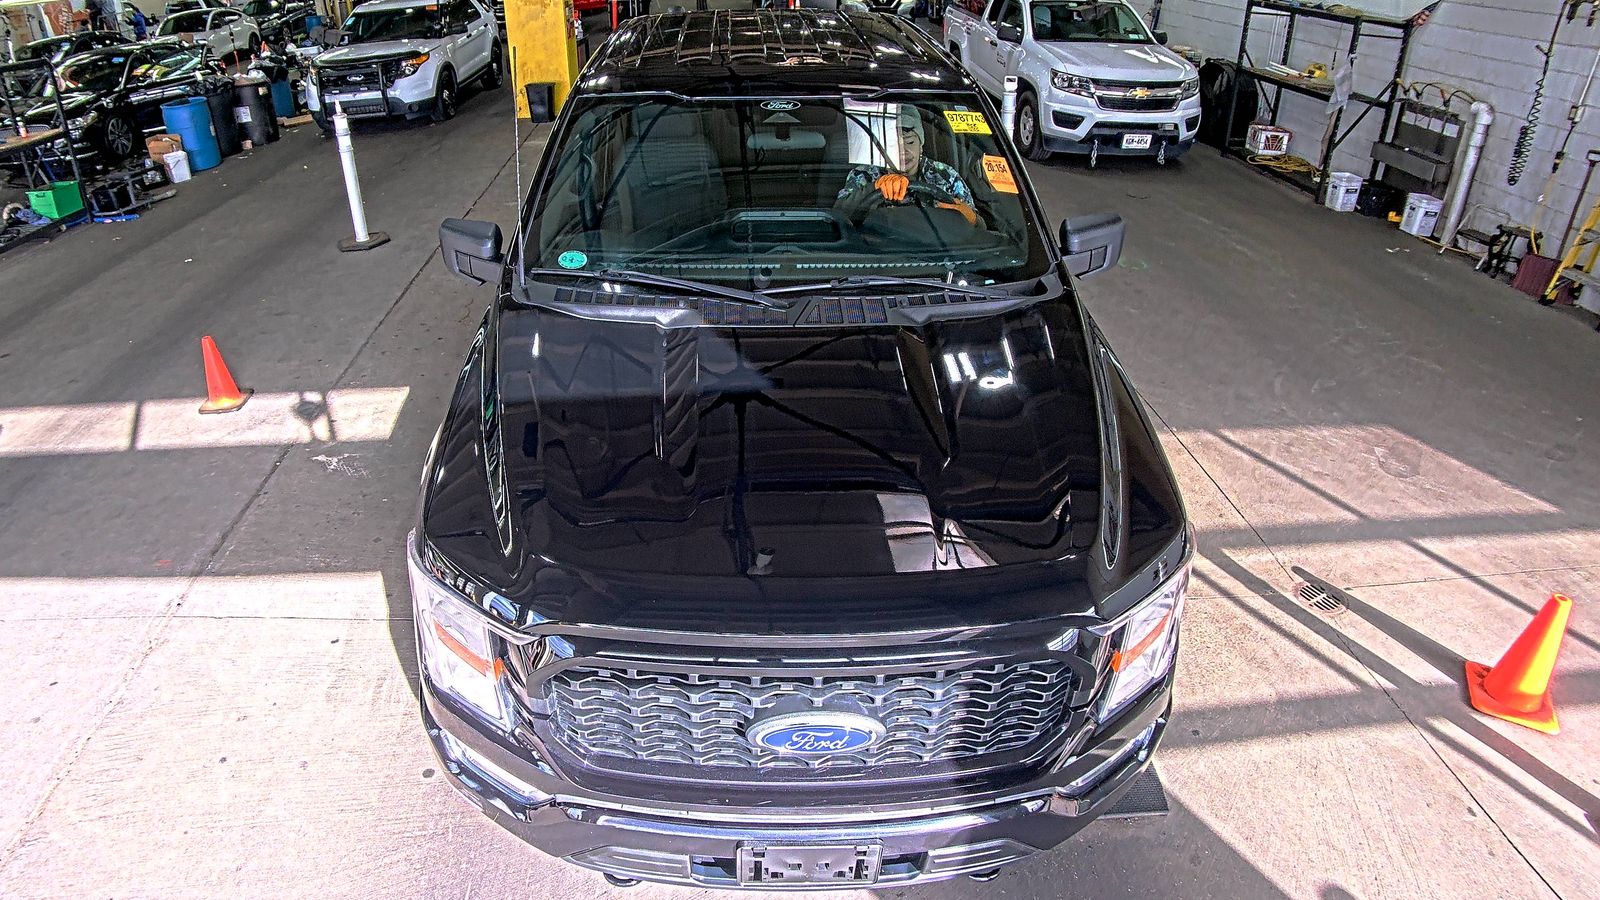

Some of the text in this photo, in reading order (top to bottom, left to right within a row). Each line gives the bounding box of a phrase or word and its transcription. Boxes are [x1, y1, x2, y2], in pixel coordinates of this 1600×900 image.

[767, 101, 794, 109] Ford
[947, 113, 986, 124] 9787743
[785, 731, 850, 750] Ford
